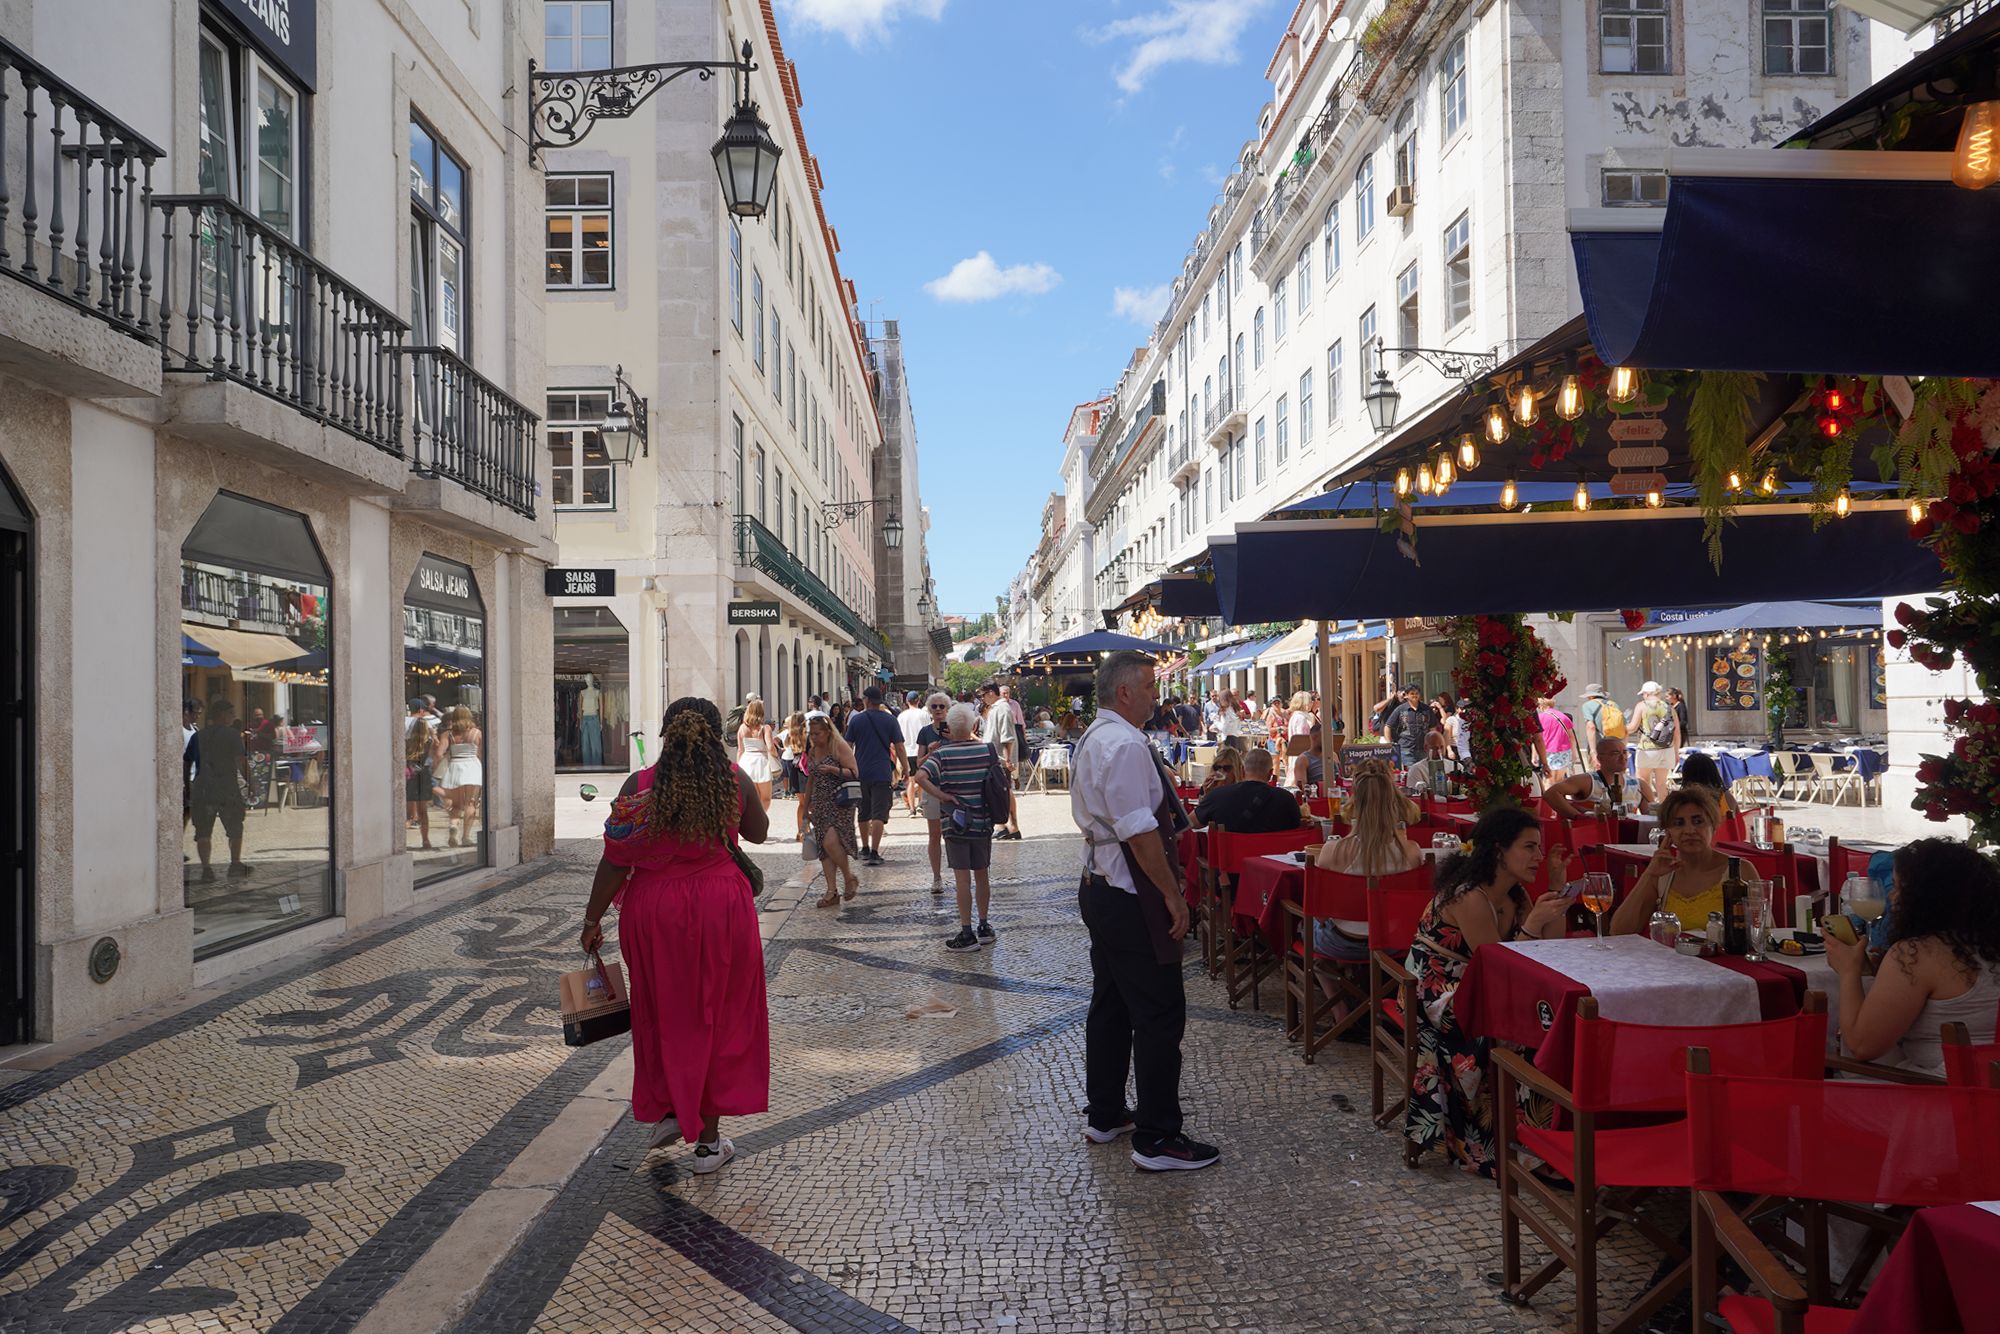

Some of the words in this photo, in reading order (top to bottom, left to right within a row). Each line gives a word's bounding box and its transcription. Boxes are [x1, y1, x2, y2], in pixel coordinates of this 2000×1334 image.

[241, 0, 290, 46] ANS
[565, 572, 597, 582] SALSA
[420, 567, 445, 593] SALSA
[445, 574, 469, 599] JEANS
[564, 583, 597, 594] JEANS
[731, 609, 778, 617] BERSHKA
[1660, 612, 1684, 621] Costa
[1349, 750, 1373, 758] Happy
